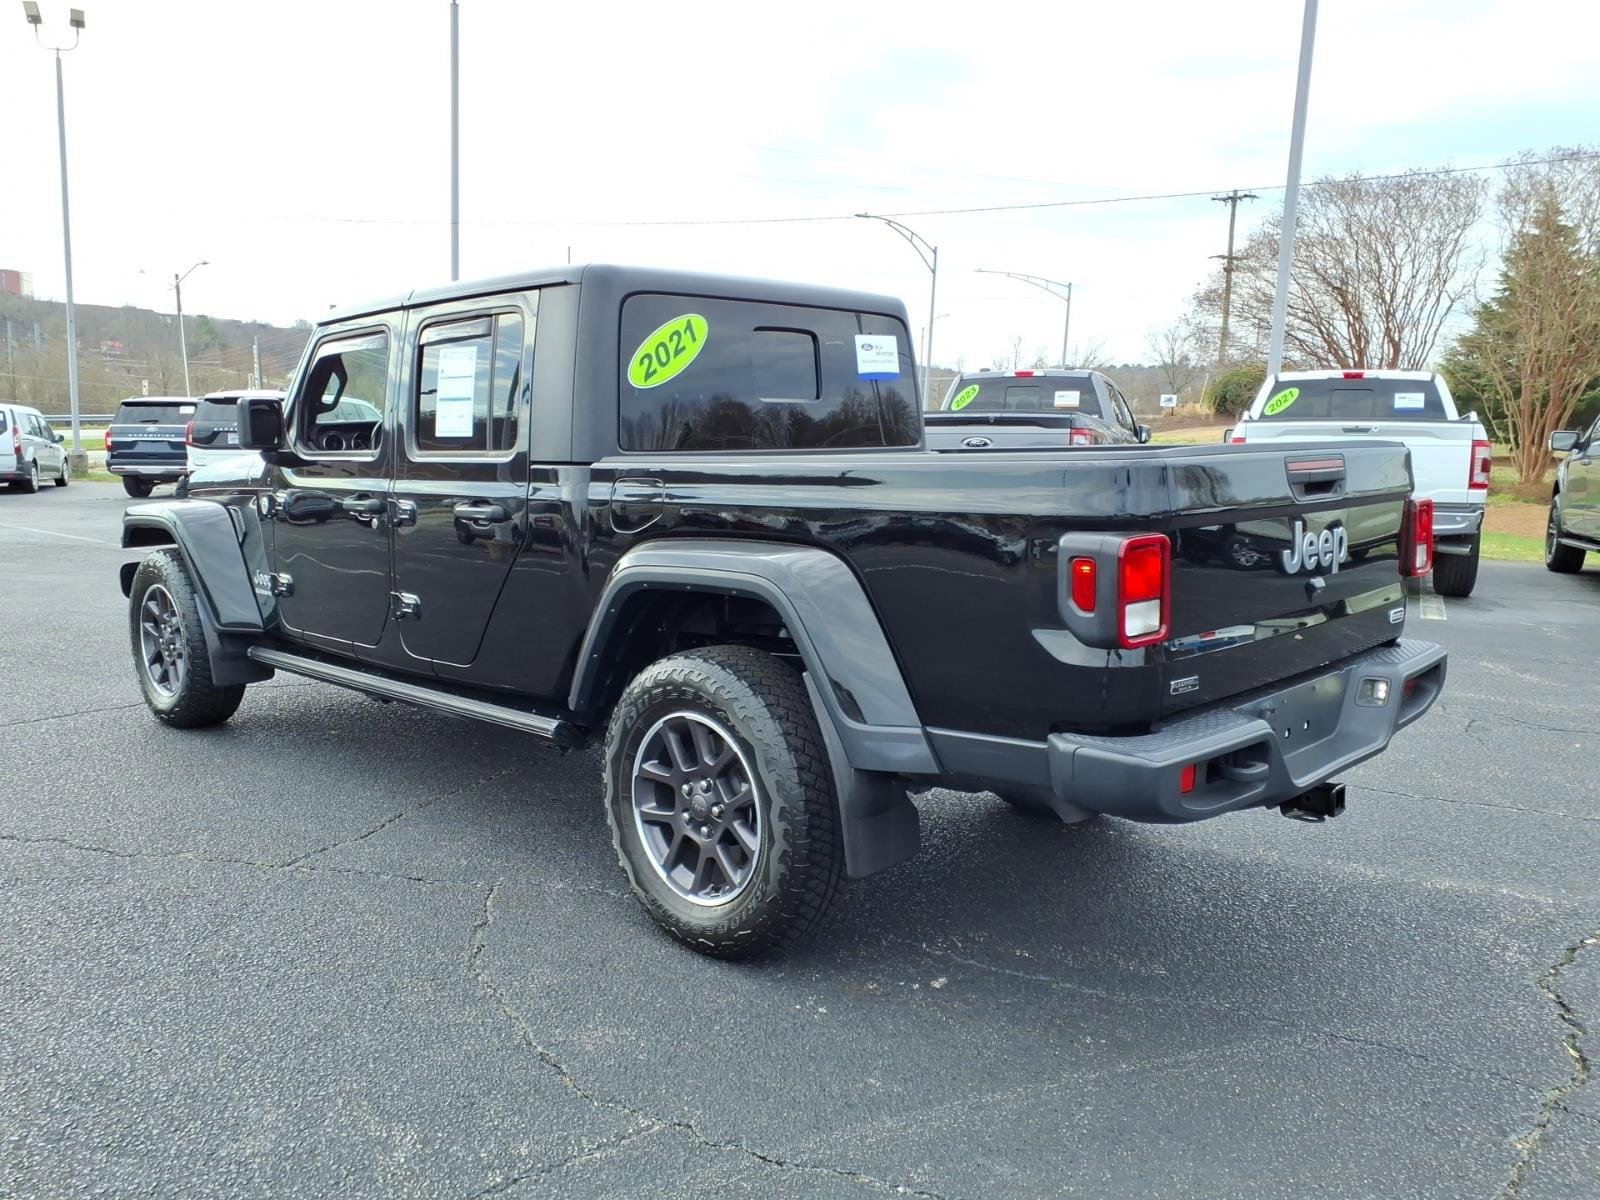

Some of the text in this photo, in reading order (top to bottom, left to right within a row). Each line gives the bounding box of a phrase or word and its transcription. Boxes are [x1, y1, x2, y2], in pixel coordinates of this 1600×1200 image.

[639, 318, 697, 383] 2021
[1269, 390, 1295, 413] 2021
[1282, 520, 1348, 575] Jeep
